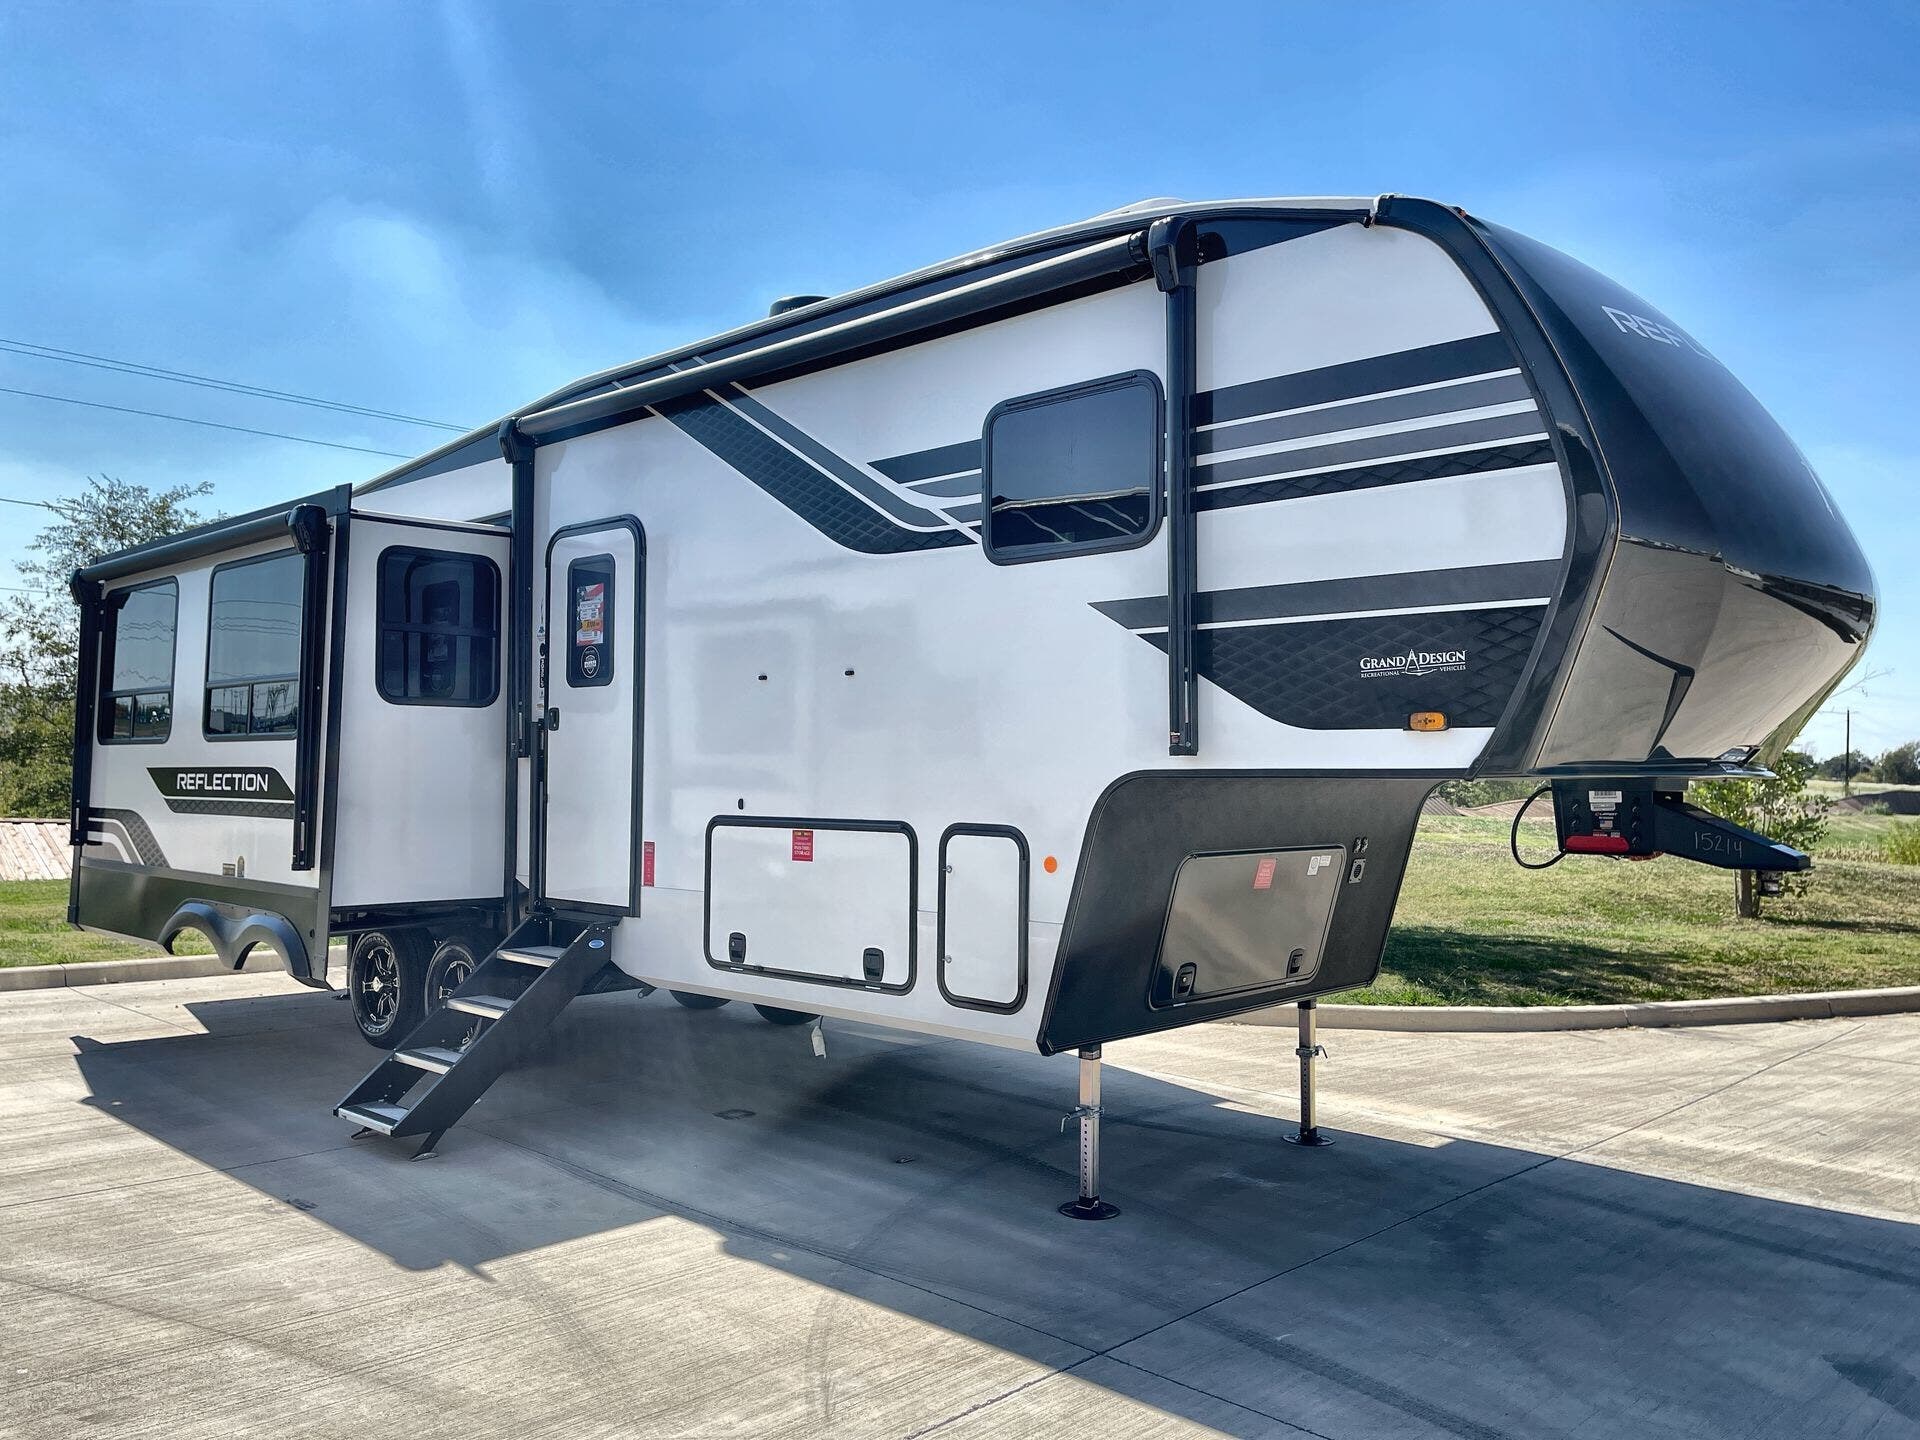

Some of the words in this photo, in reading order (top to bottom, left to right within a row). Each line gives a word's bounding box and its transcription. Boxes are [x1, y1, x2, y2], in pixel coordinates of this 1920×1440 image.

[1360, 656, 1405, 670] GRAND
[1419, 650, 1466, 665] DESIGN
[1361, 670, 1400, 678] RECREATIONAL
[1440, 664, 1466, 672] VEHICLES
[176, 773, 269, 792] REFLECTION
[1694, 831, 1742, 859] 15214
